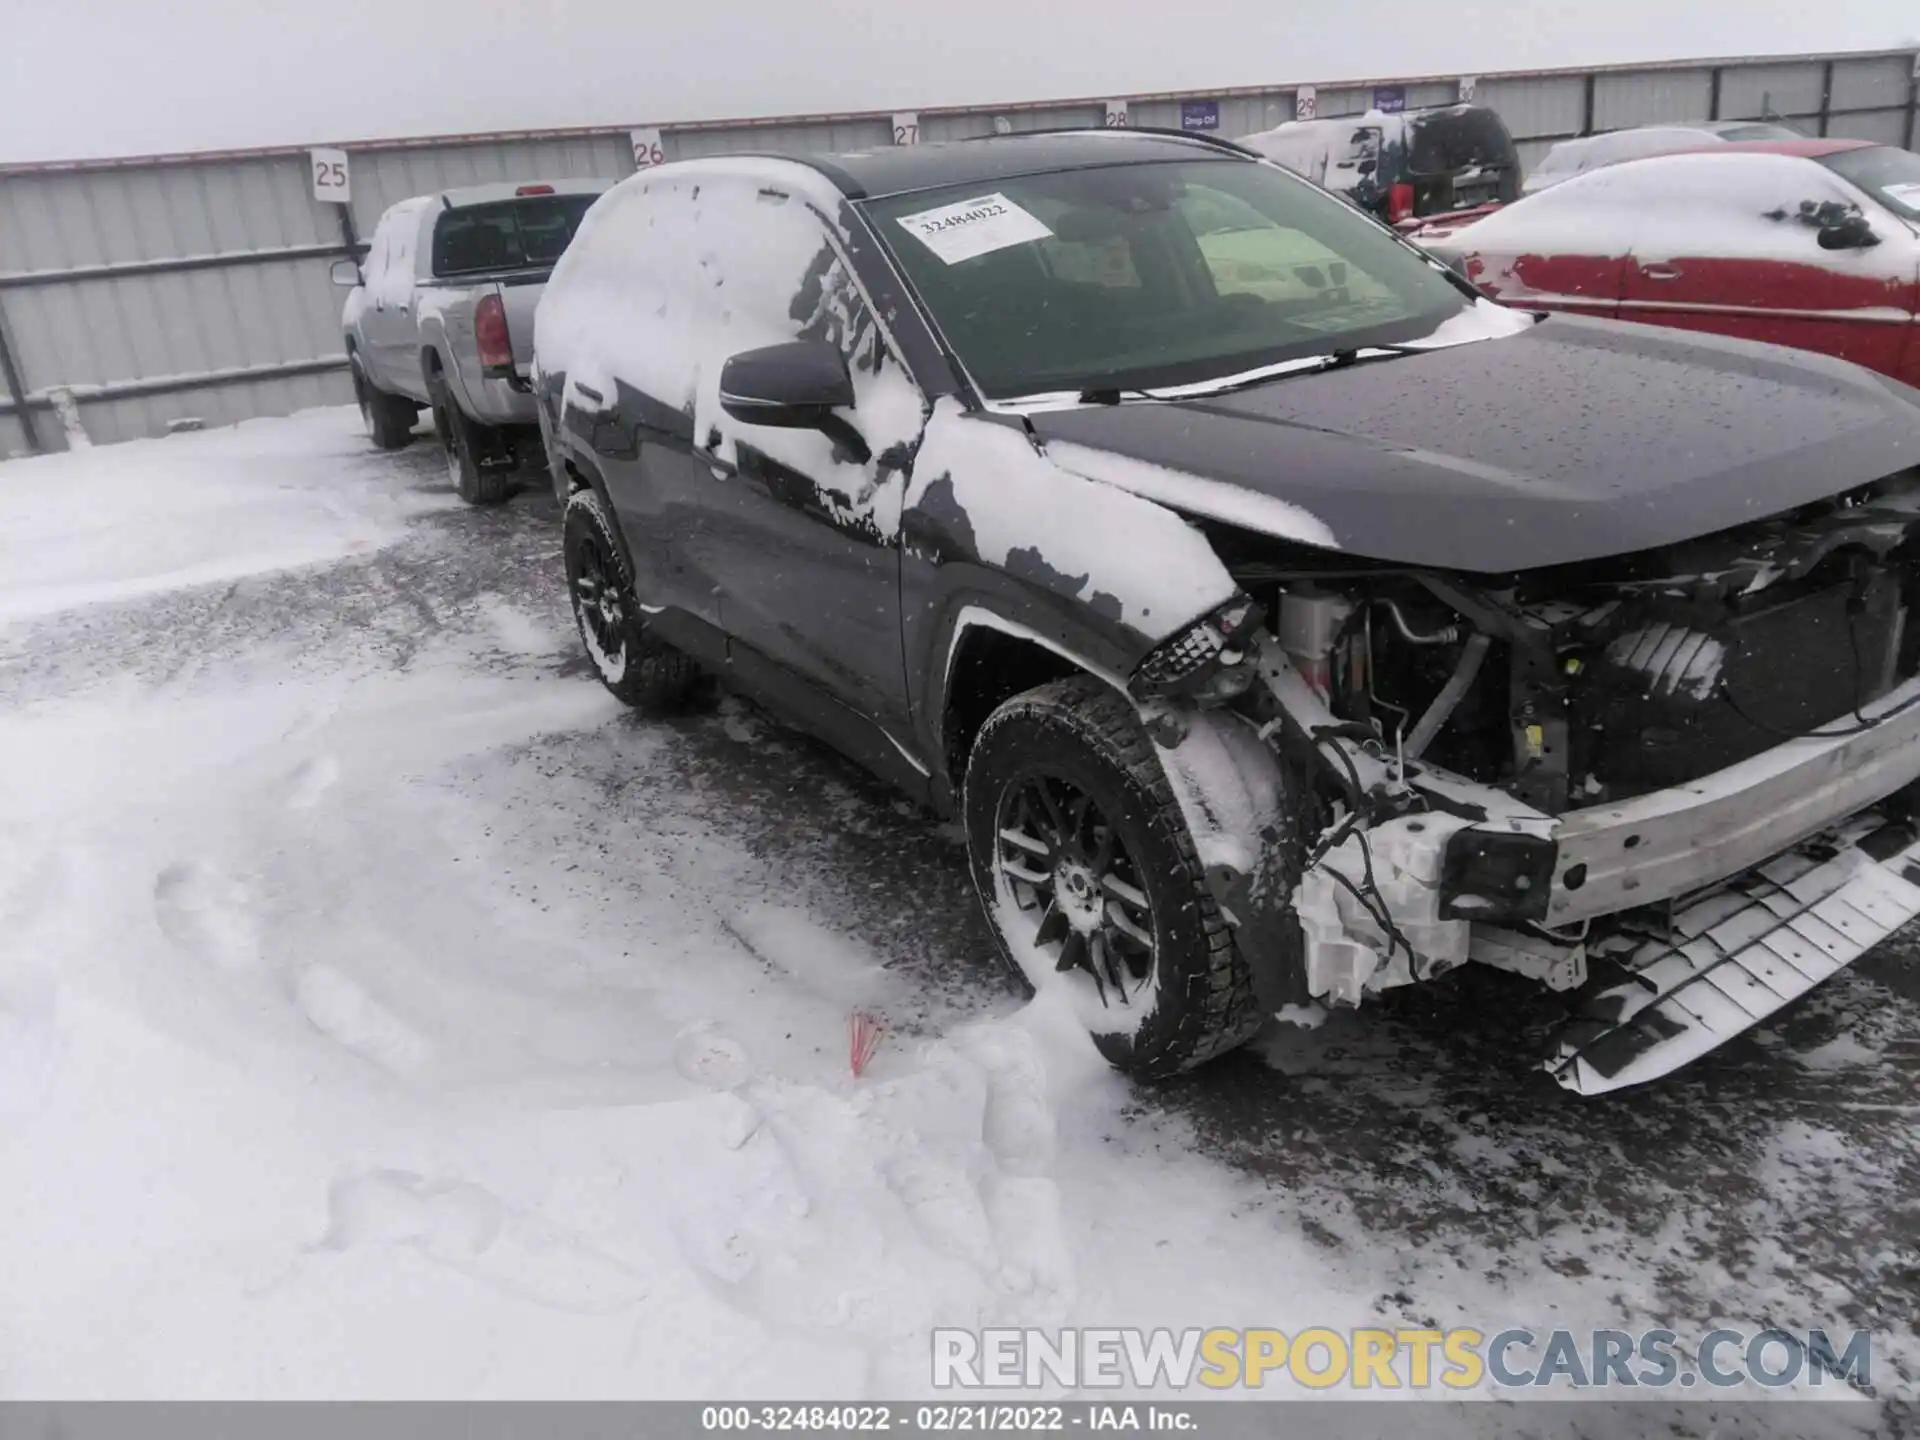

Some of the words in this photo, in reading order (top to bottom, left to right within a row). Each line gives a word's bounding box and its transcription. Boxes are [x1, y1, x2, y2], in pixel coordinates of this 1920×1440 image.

[1298, 98, 1315, 116] 29
[1107, 112, 1126, 127] 28
[895, 125, 917, 146] 27
[635, 142, 664, 166] 26
[316, 161, 346, 187] 25
[920, 204, 1008, 234] 32484022
